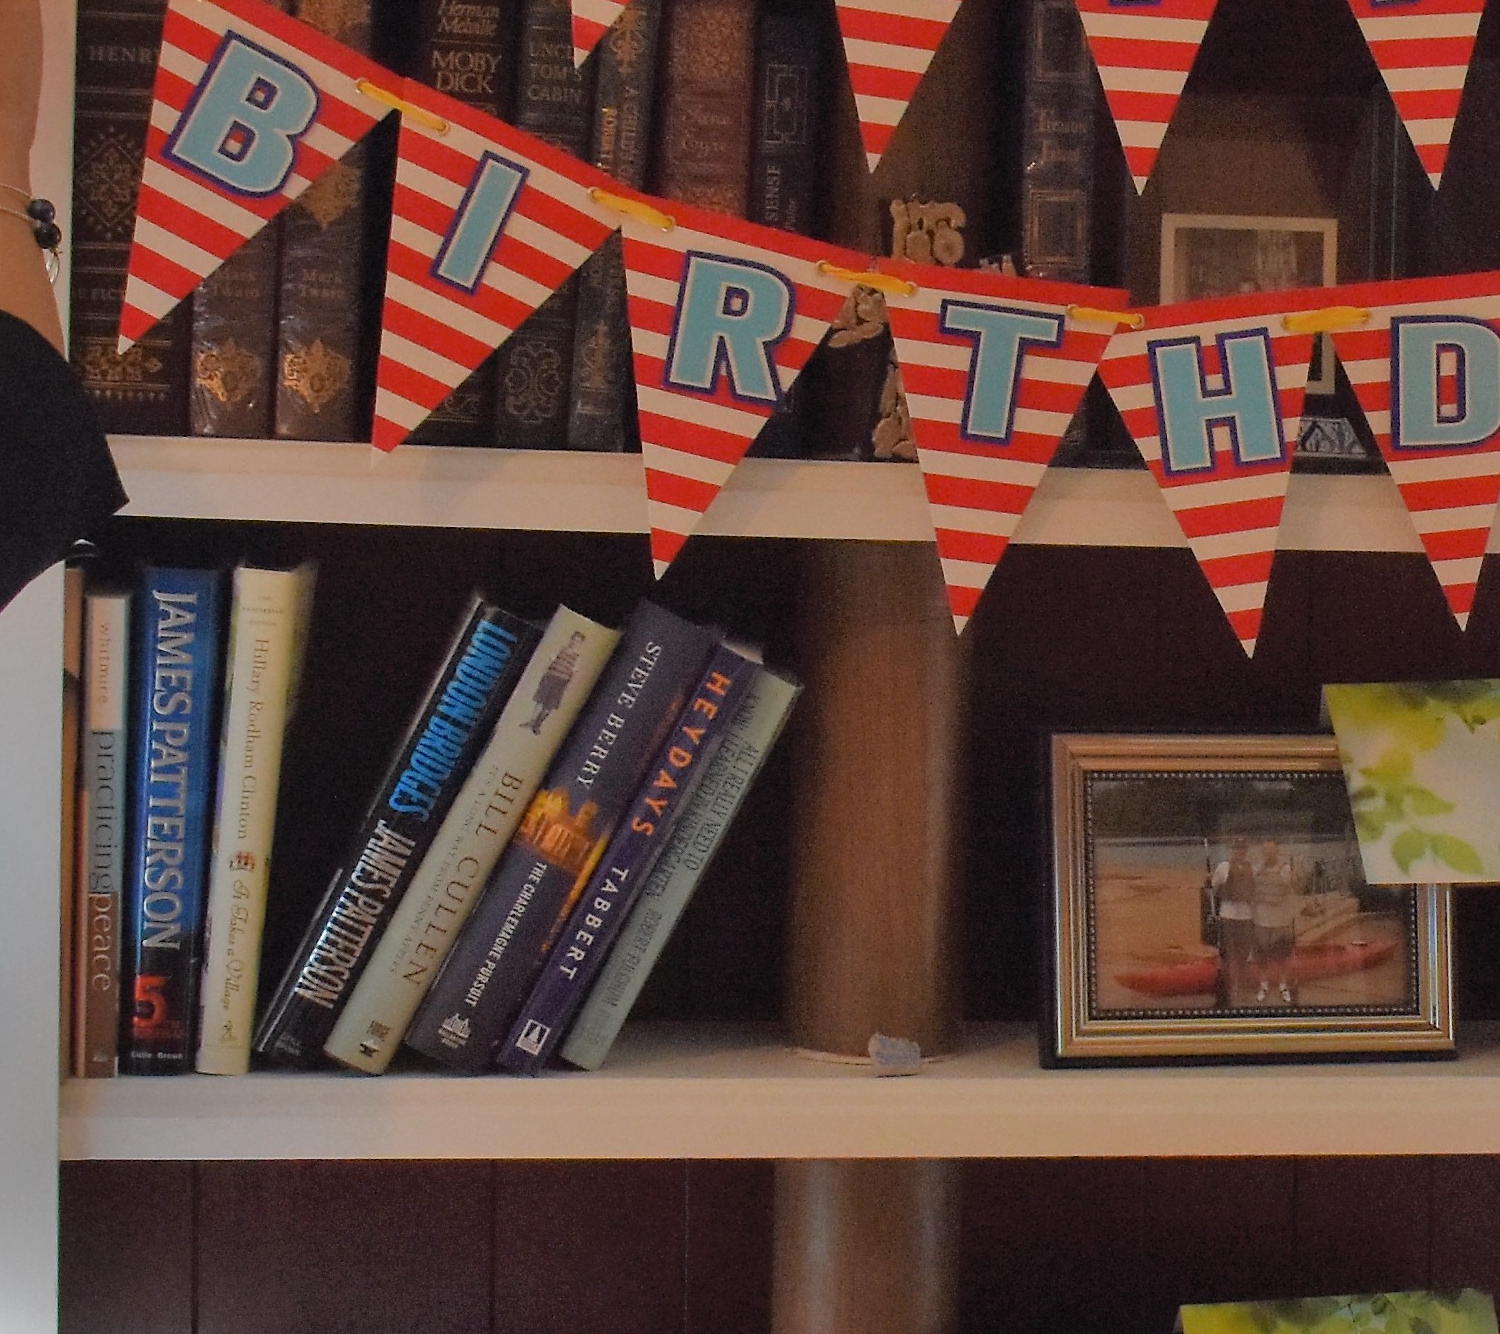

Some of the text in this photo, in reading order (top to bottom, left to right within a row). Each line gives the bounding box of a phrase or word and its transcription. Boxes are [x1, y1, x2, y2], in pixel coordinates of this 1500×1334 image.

[89, 46, 158, 65] HENR
[431, 50, 502, 74] MOBY
[436, 72, 494, 95] DICK
[526, 84, 582, 103] CABIN
[96, 621, 112, 704] whitmire
[236, 637, 269, 839] Hillary Rodham Clinton
[387, 618, 518, 823] LONDON BRIDGES
[575, 641, 662, 789] STEVE BERRY
[631, 672, 729, 835] HEYDAYS
[735, 740, 759, 769] ALL
[141, 590, 197, 949] JAMES PATTERSON
[697, 737, 738, 796] LEARNED
[709, 773, 743, 818] REALLY
[86, 730, 119, 990] practicing peace
[643, 807, 701, 900] KINDERGARTEN
[681, 849, 704, 873] TO
[691, 817, 720, 853] NEED
[290, 818, 419, 1010] JAMES PATTERSON
[401, 771, 522, 985] BILL CULLEN
[225, 905, 248, 946] Takes
[225, 947, 235, 957] a
[463, 860, 547, 1007] THE CHARLEMAGNE PURSUIT
[557, 865, 628, 979] TABBERT
[601, 908, 663, 1008] ROBERT FULGHUM
[216, 958, 243, 1011] Village
